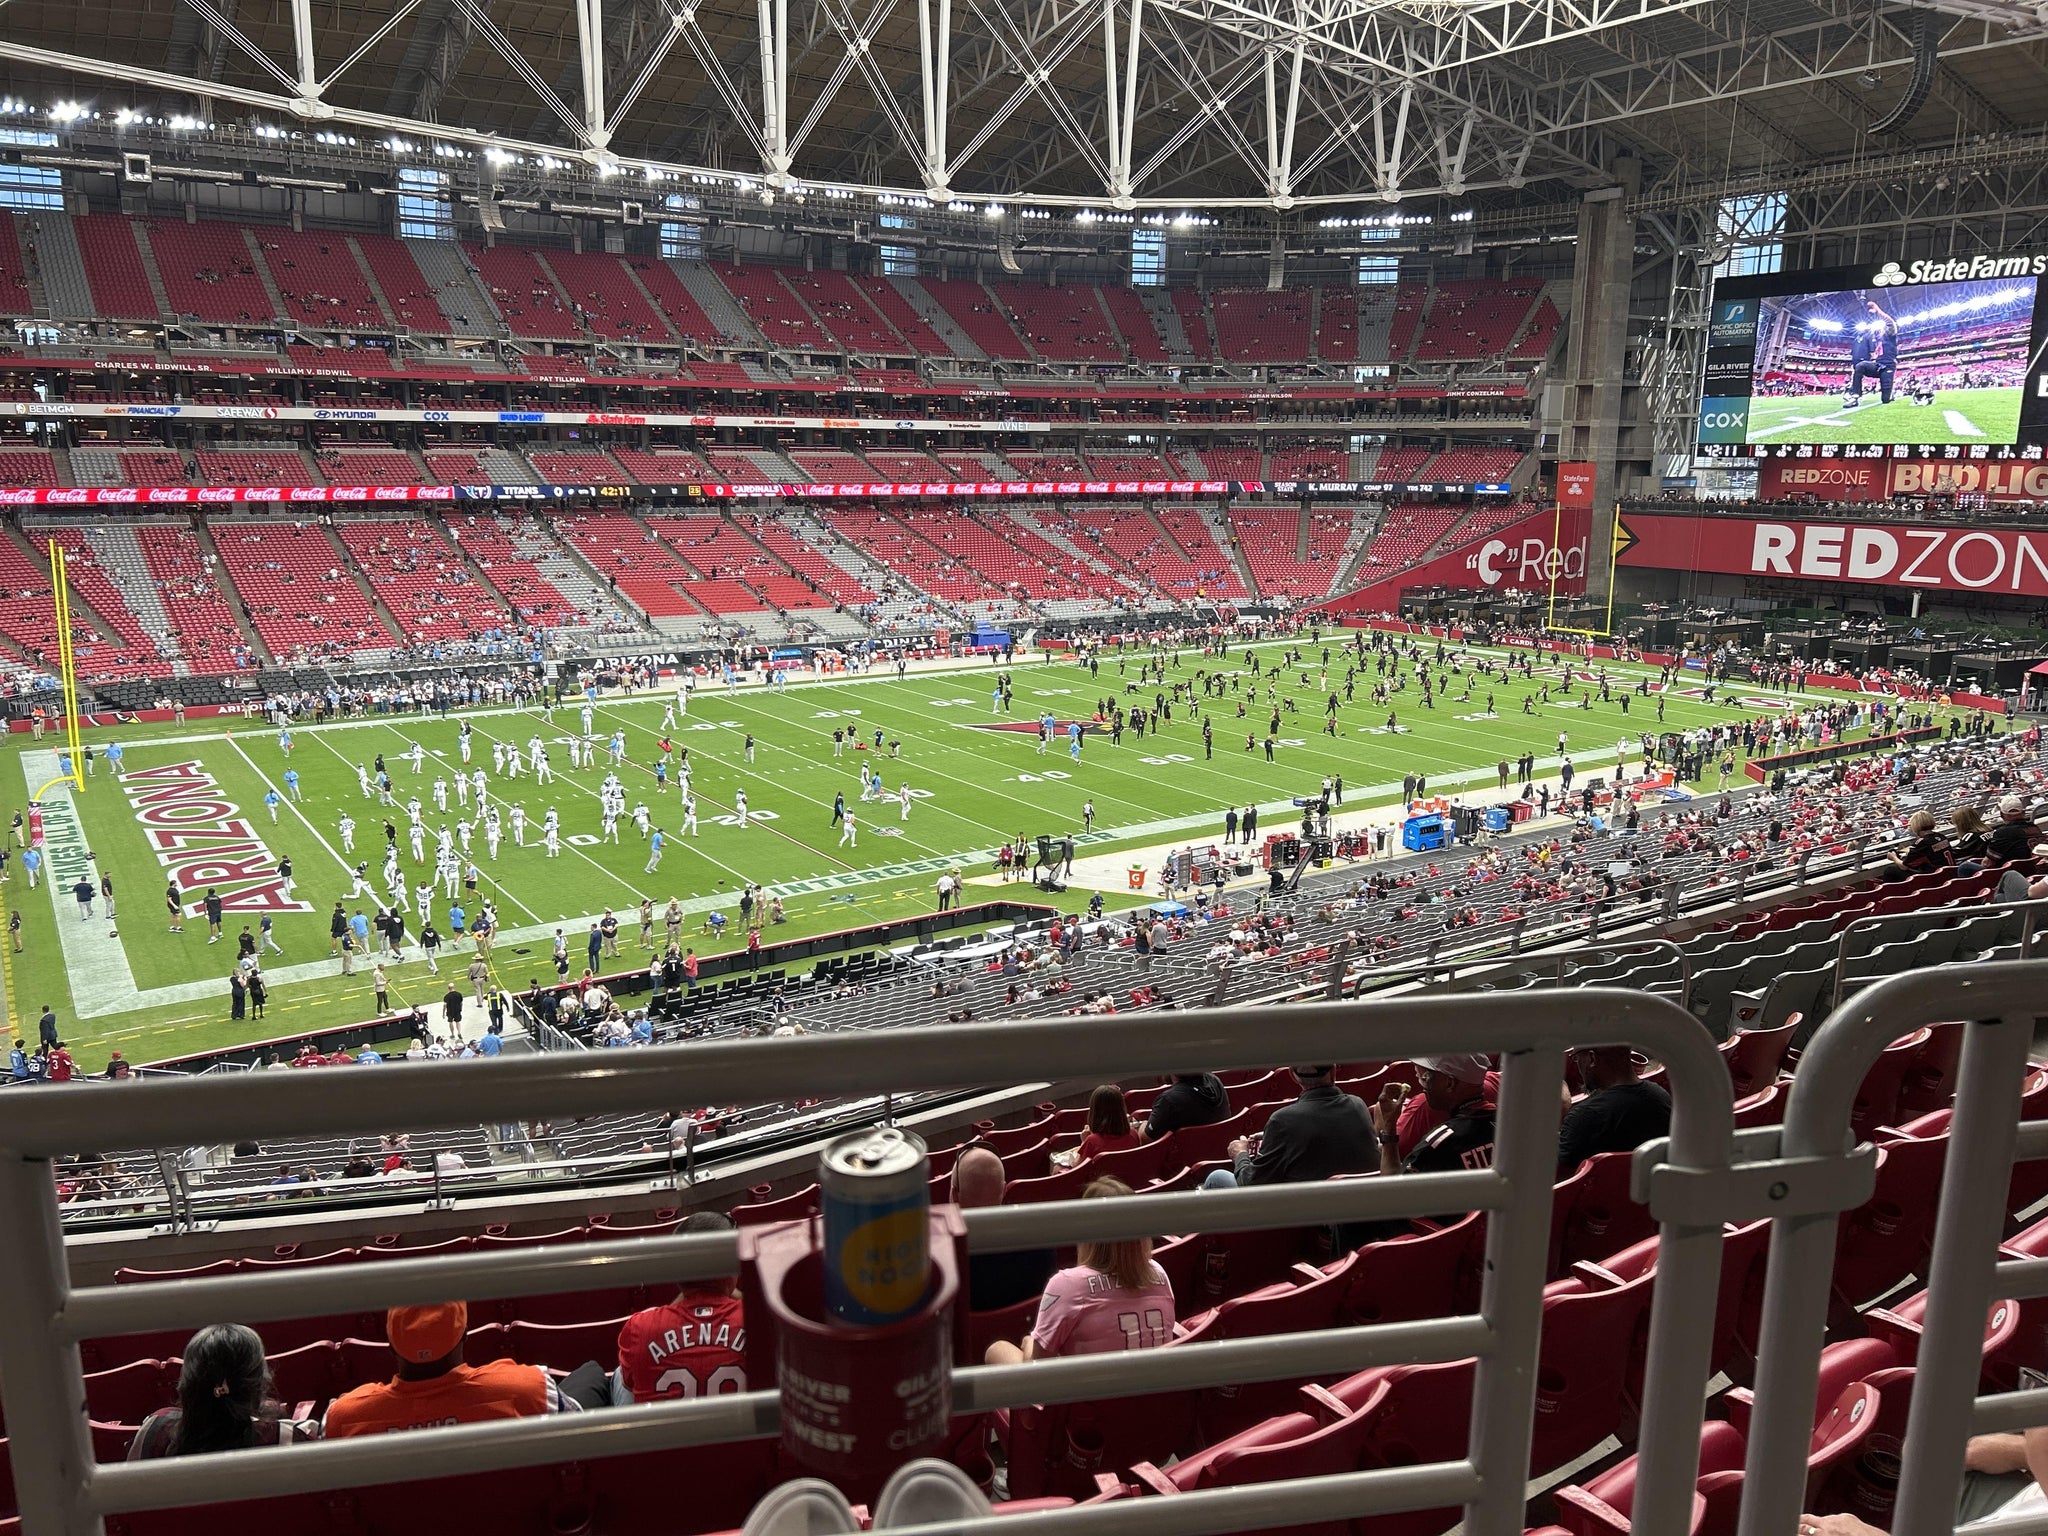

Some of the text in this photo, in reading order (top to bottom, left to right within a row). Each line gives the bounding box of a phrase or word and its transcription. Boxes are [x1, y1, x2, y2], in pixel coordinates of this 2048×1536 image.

[1713, 328, 1753, 336] AUTOMATION
[95, 361, 139, 369] CHARLES
[155, 363, 196, 371] BIDWILL,
[197, 364, 212, 372] SR.
[266, 367, 304, 375] WILLIAM
[1726, 362, 1750, 370] RIVER
[29, 404, 74, 413] BETMGM
[127, 406, 165, 414] FINANCIAL
[217, 408, 263, 417] SAFEWAY
[423, 411, 449, 421] COX
[500, 413, 544, 422] BUD LIGHT
[1704, 412, 1745, 428] COX
[998, 422, 1030, 431] AVNET
[1704, 444, 1737, 457] 42:11
[1893, 464, 1981, 493] BUD
[503, 486, 564, 497] TITANS 0
[600, 486, 631, 497] 42:11
[715, 485, 780, 495] 0 CARDINALS
[1308, 483, 1358, 491] K. MURRAY
[1419, 484, 1433, 492] 742
[1137, 753, 1195, 766] 50
[1017, 769, 1073, 783] 40
[39, 800, 70, 814] US
[41, 813, 74, 826] OF
[44, 825, 81, 844] ALL
[117, 759, 316, 919] ARIZONA
[49, 845, 91, 881] TAKES
[768, 855, 969, 897] INTERCEPT
[1117, 1308, 1165, 1351] 11
